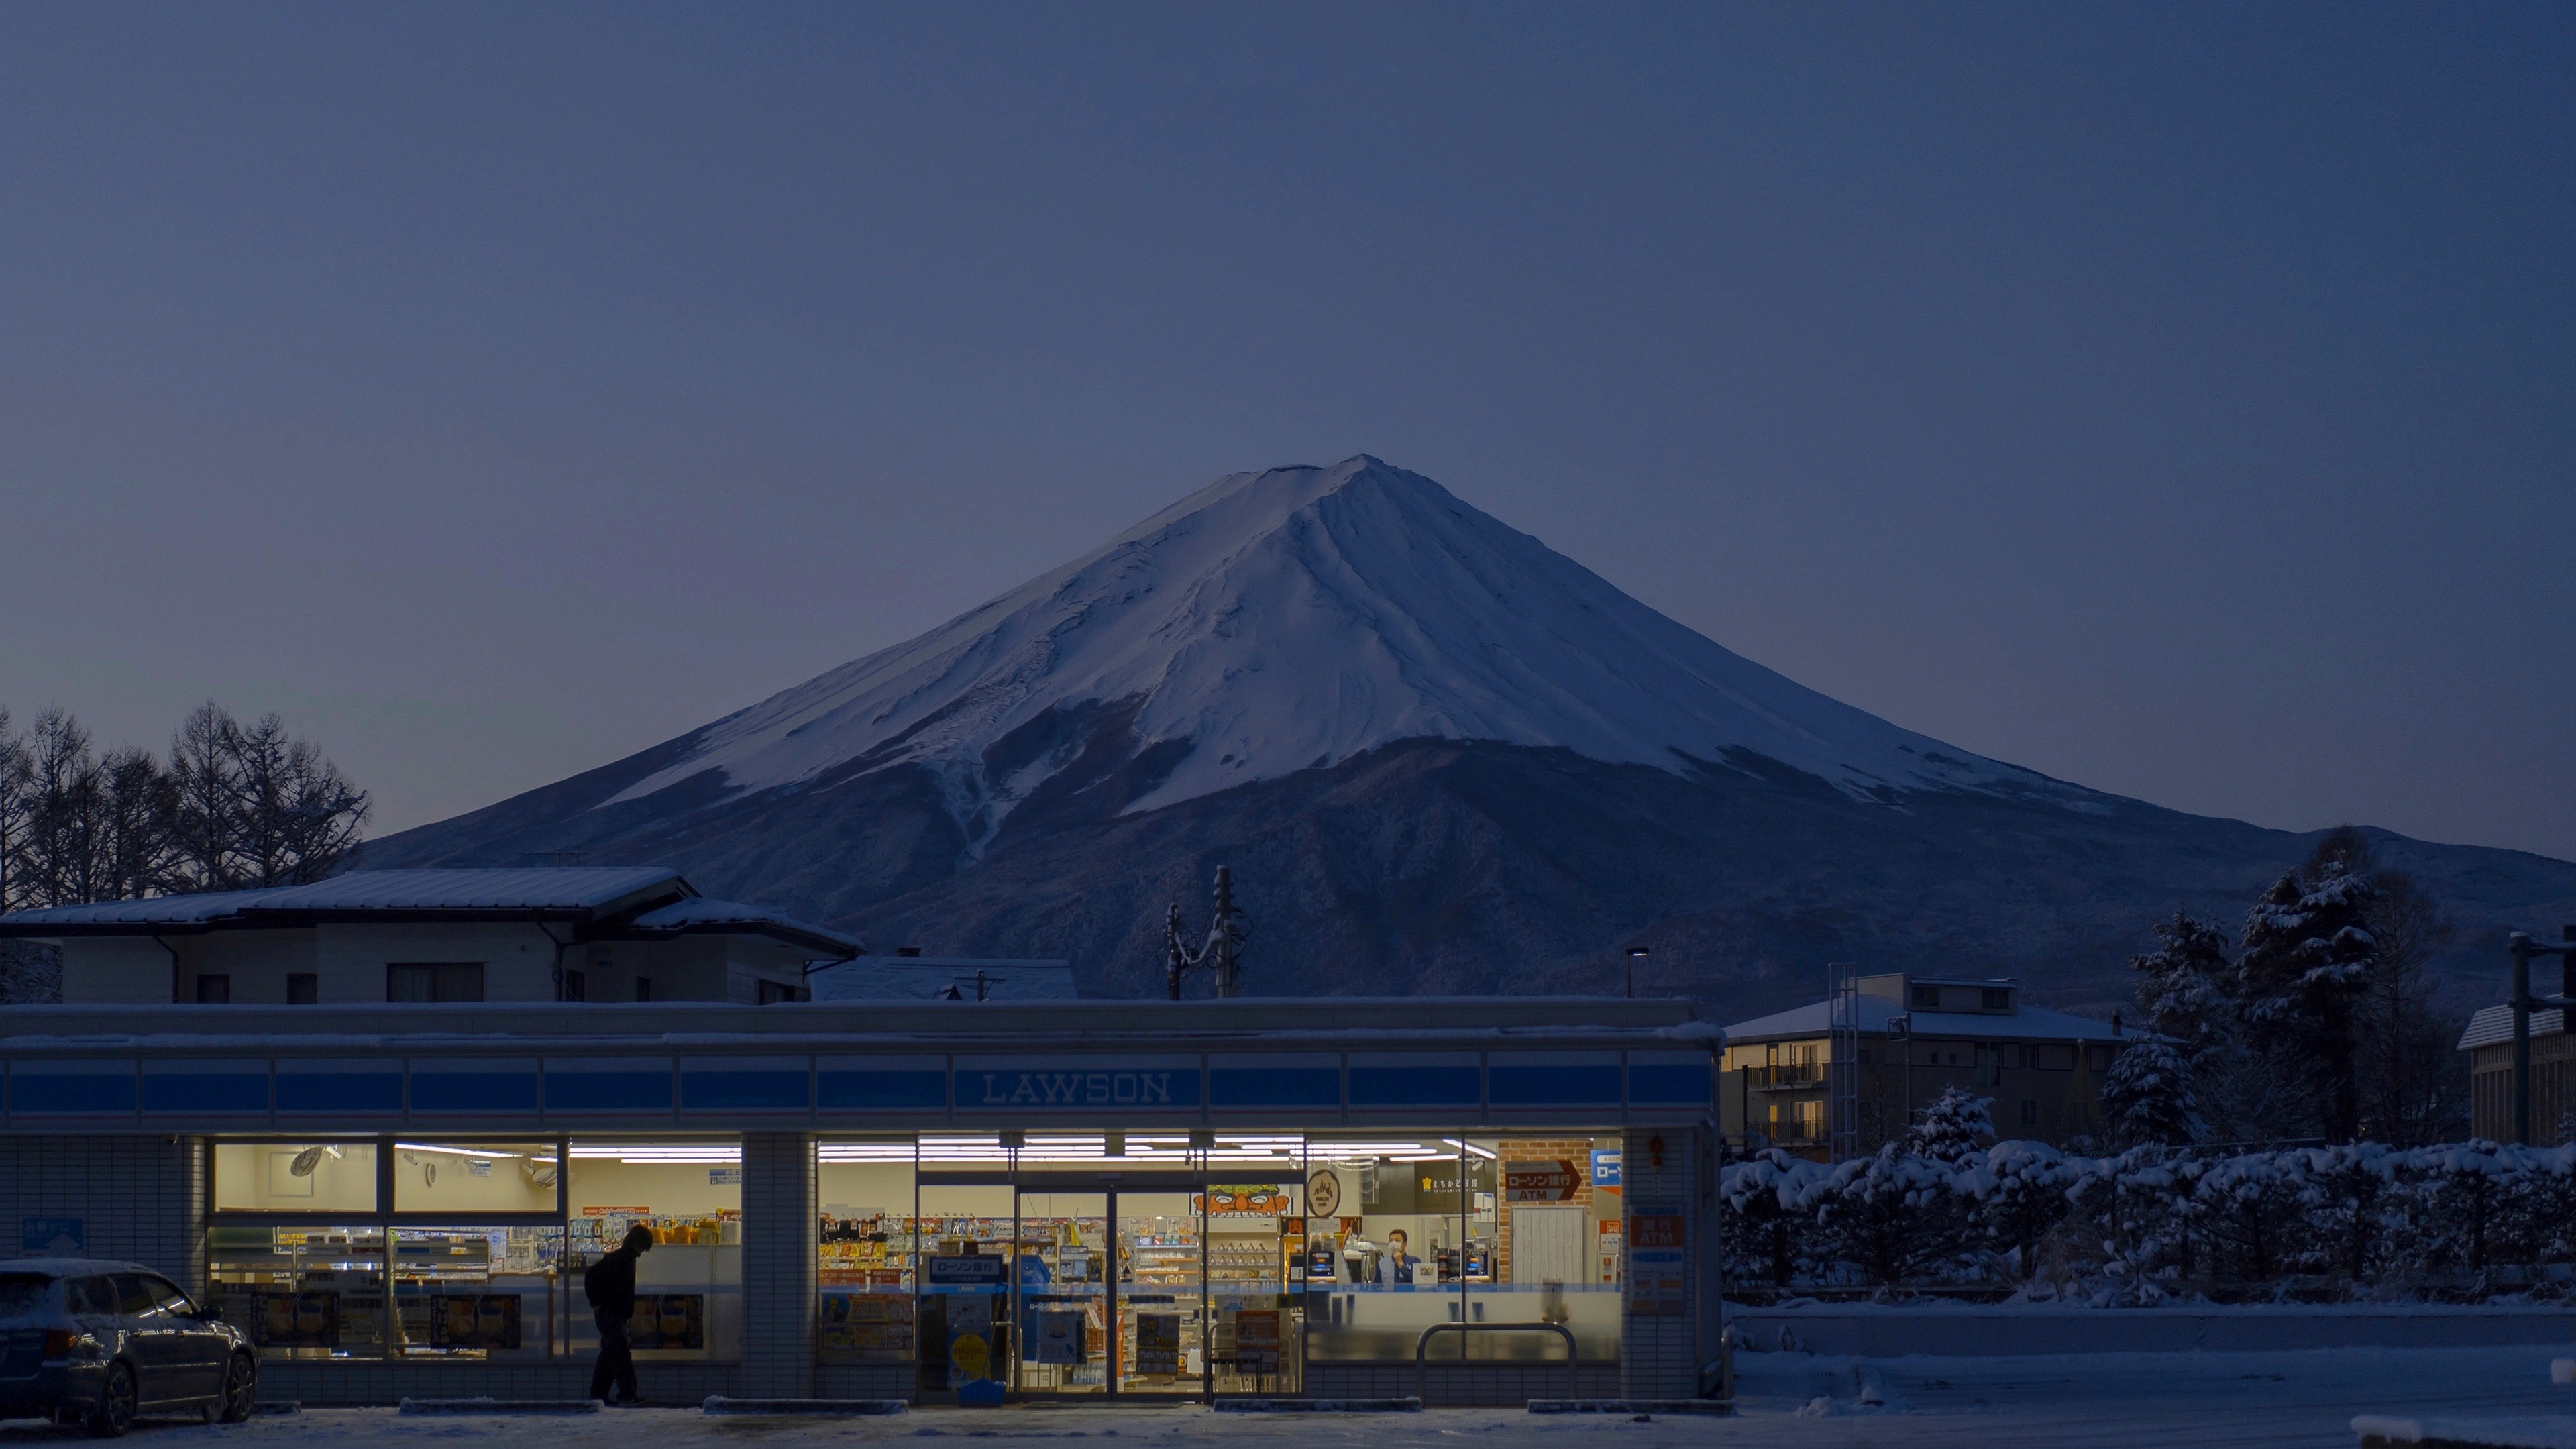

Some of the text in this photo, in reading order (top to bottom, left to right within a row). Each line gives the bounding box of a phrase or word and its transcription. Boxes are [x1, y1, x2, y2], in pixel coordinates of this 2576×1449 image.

[983, 1073, 1171, 1104] LAWSON
[1509, 1174, 1571, 1187] ローソン銀行
[1519, 1190, 1547, 1200] ATM
[1640, 1232, 1672, 1244] ATM
[938, 1262, 993, 1272] ローソン銀行
